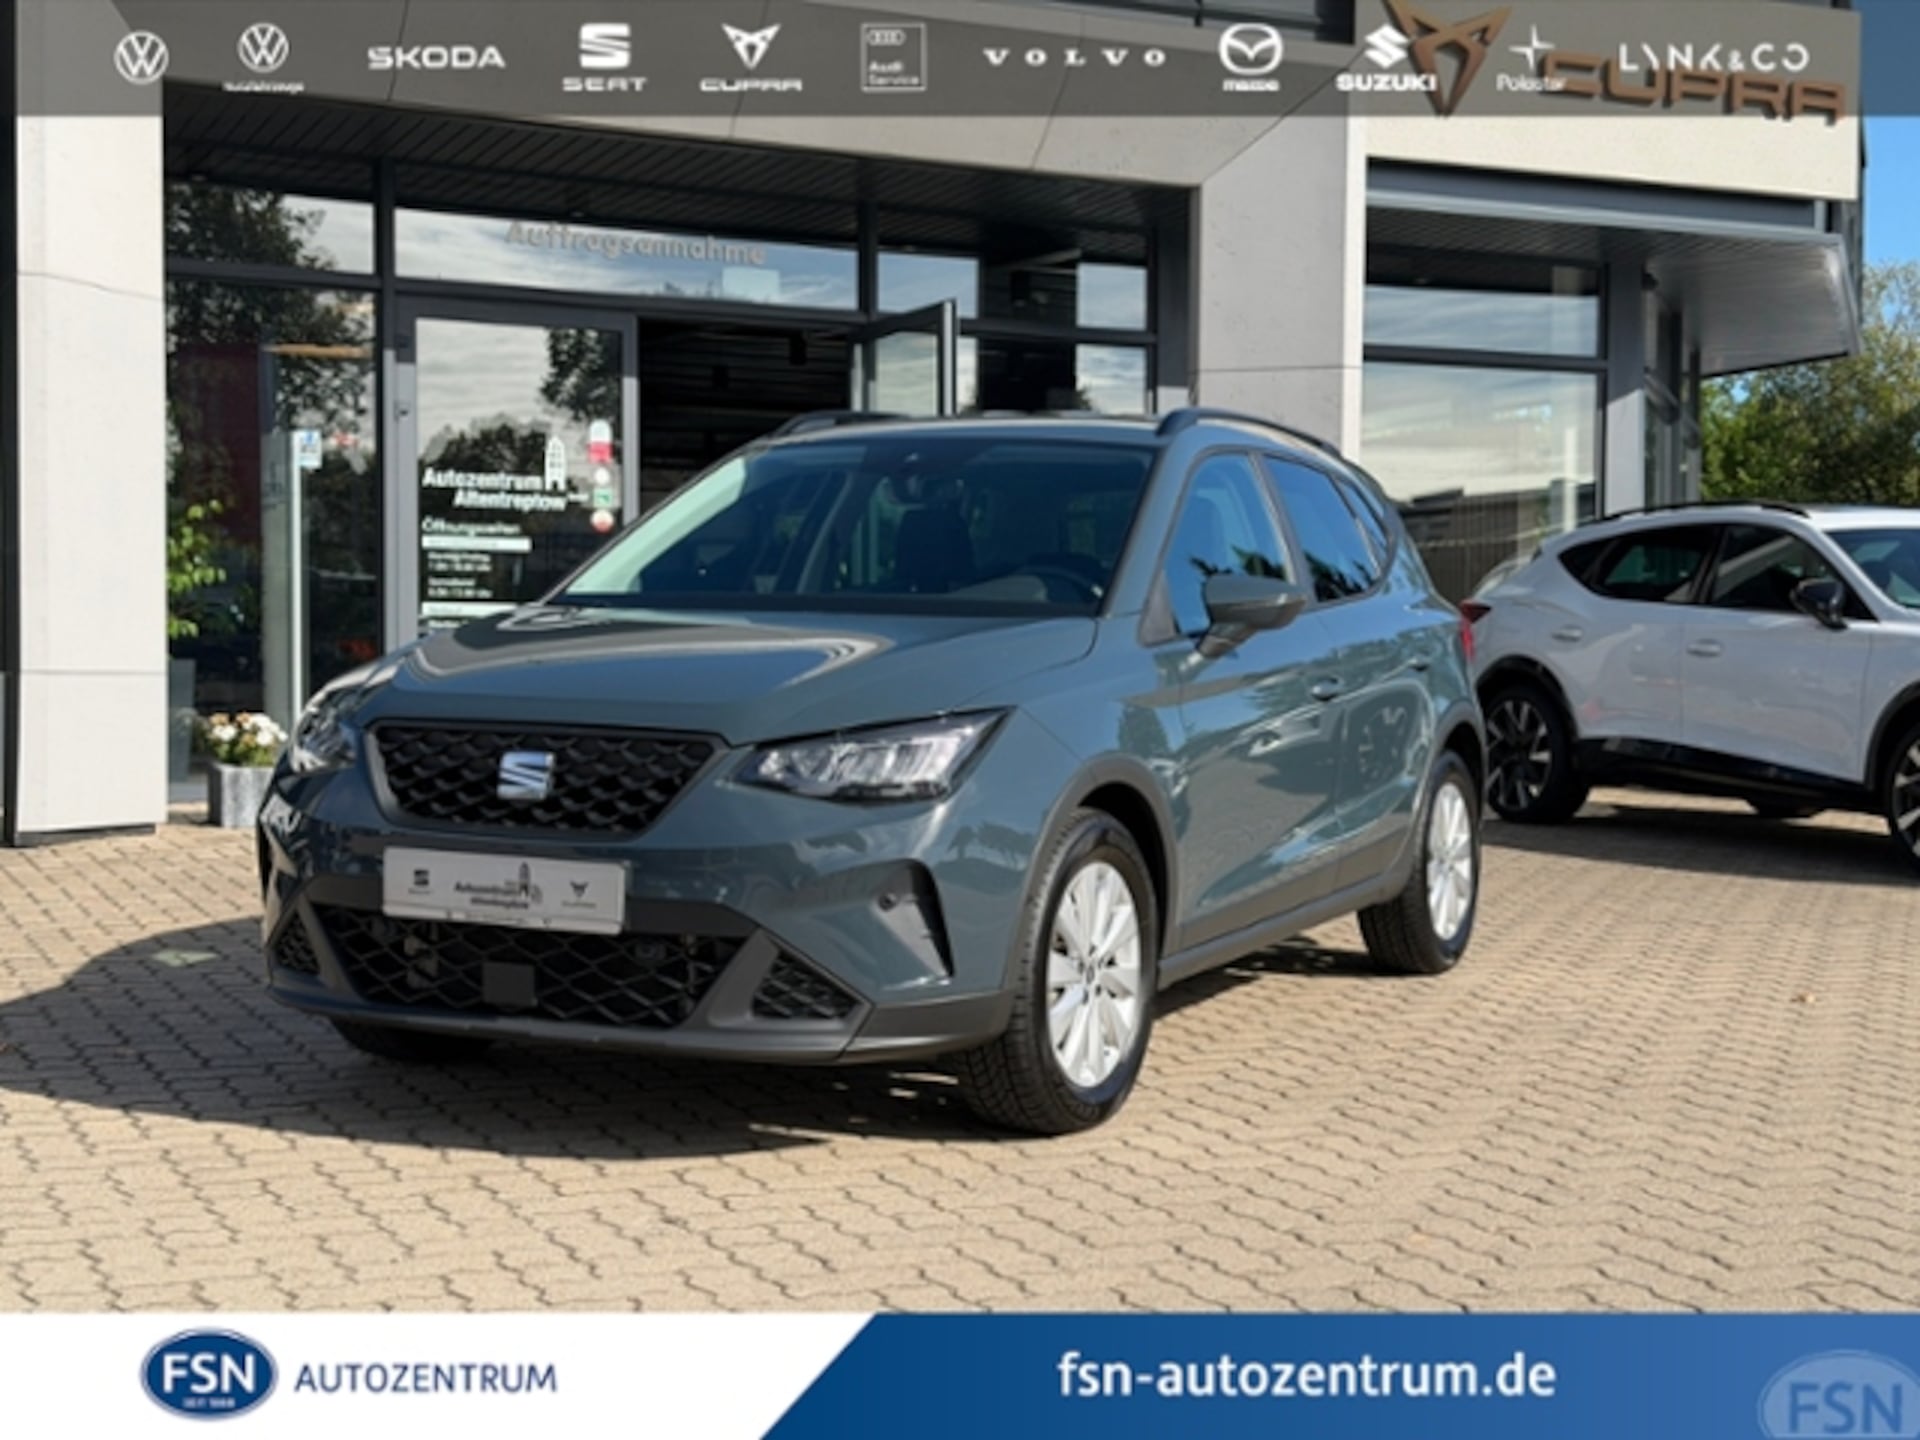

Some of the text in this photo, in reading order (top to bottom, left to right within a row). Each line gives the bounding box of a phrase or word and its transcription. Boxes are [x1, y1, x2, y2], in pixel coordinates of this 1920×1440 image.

[1536, 50, 1846, 126] CUPRA
[506, 221, 766, 265] Auftragsannahme
[422, 467, 543, 490] Autozentrum
[454, 489, 567, 513] Altentreptow
